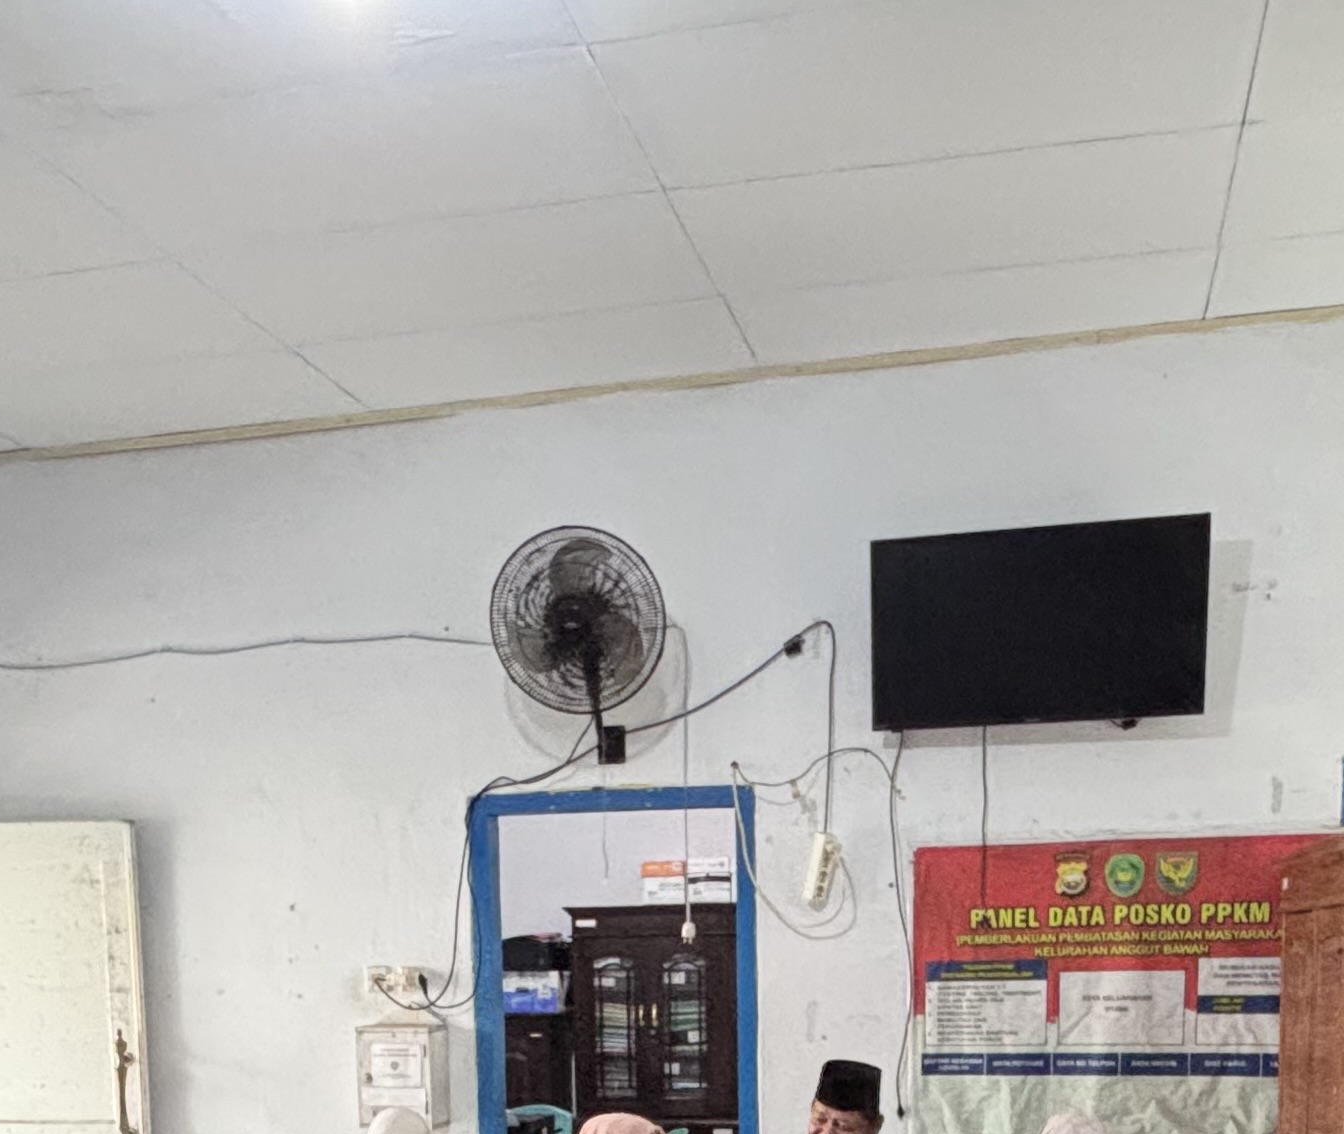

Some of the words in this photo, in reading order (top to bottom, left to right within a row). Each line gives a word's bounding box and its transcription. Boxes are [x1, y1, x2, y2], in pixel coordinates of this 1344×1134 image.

[970, 906, 1040, 929] PANEL
[1048, 905, 1105, 928] DATA
[1113, 903, 1192, 926] POSKO
[1200, 901, 1271, 924] PPKM
